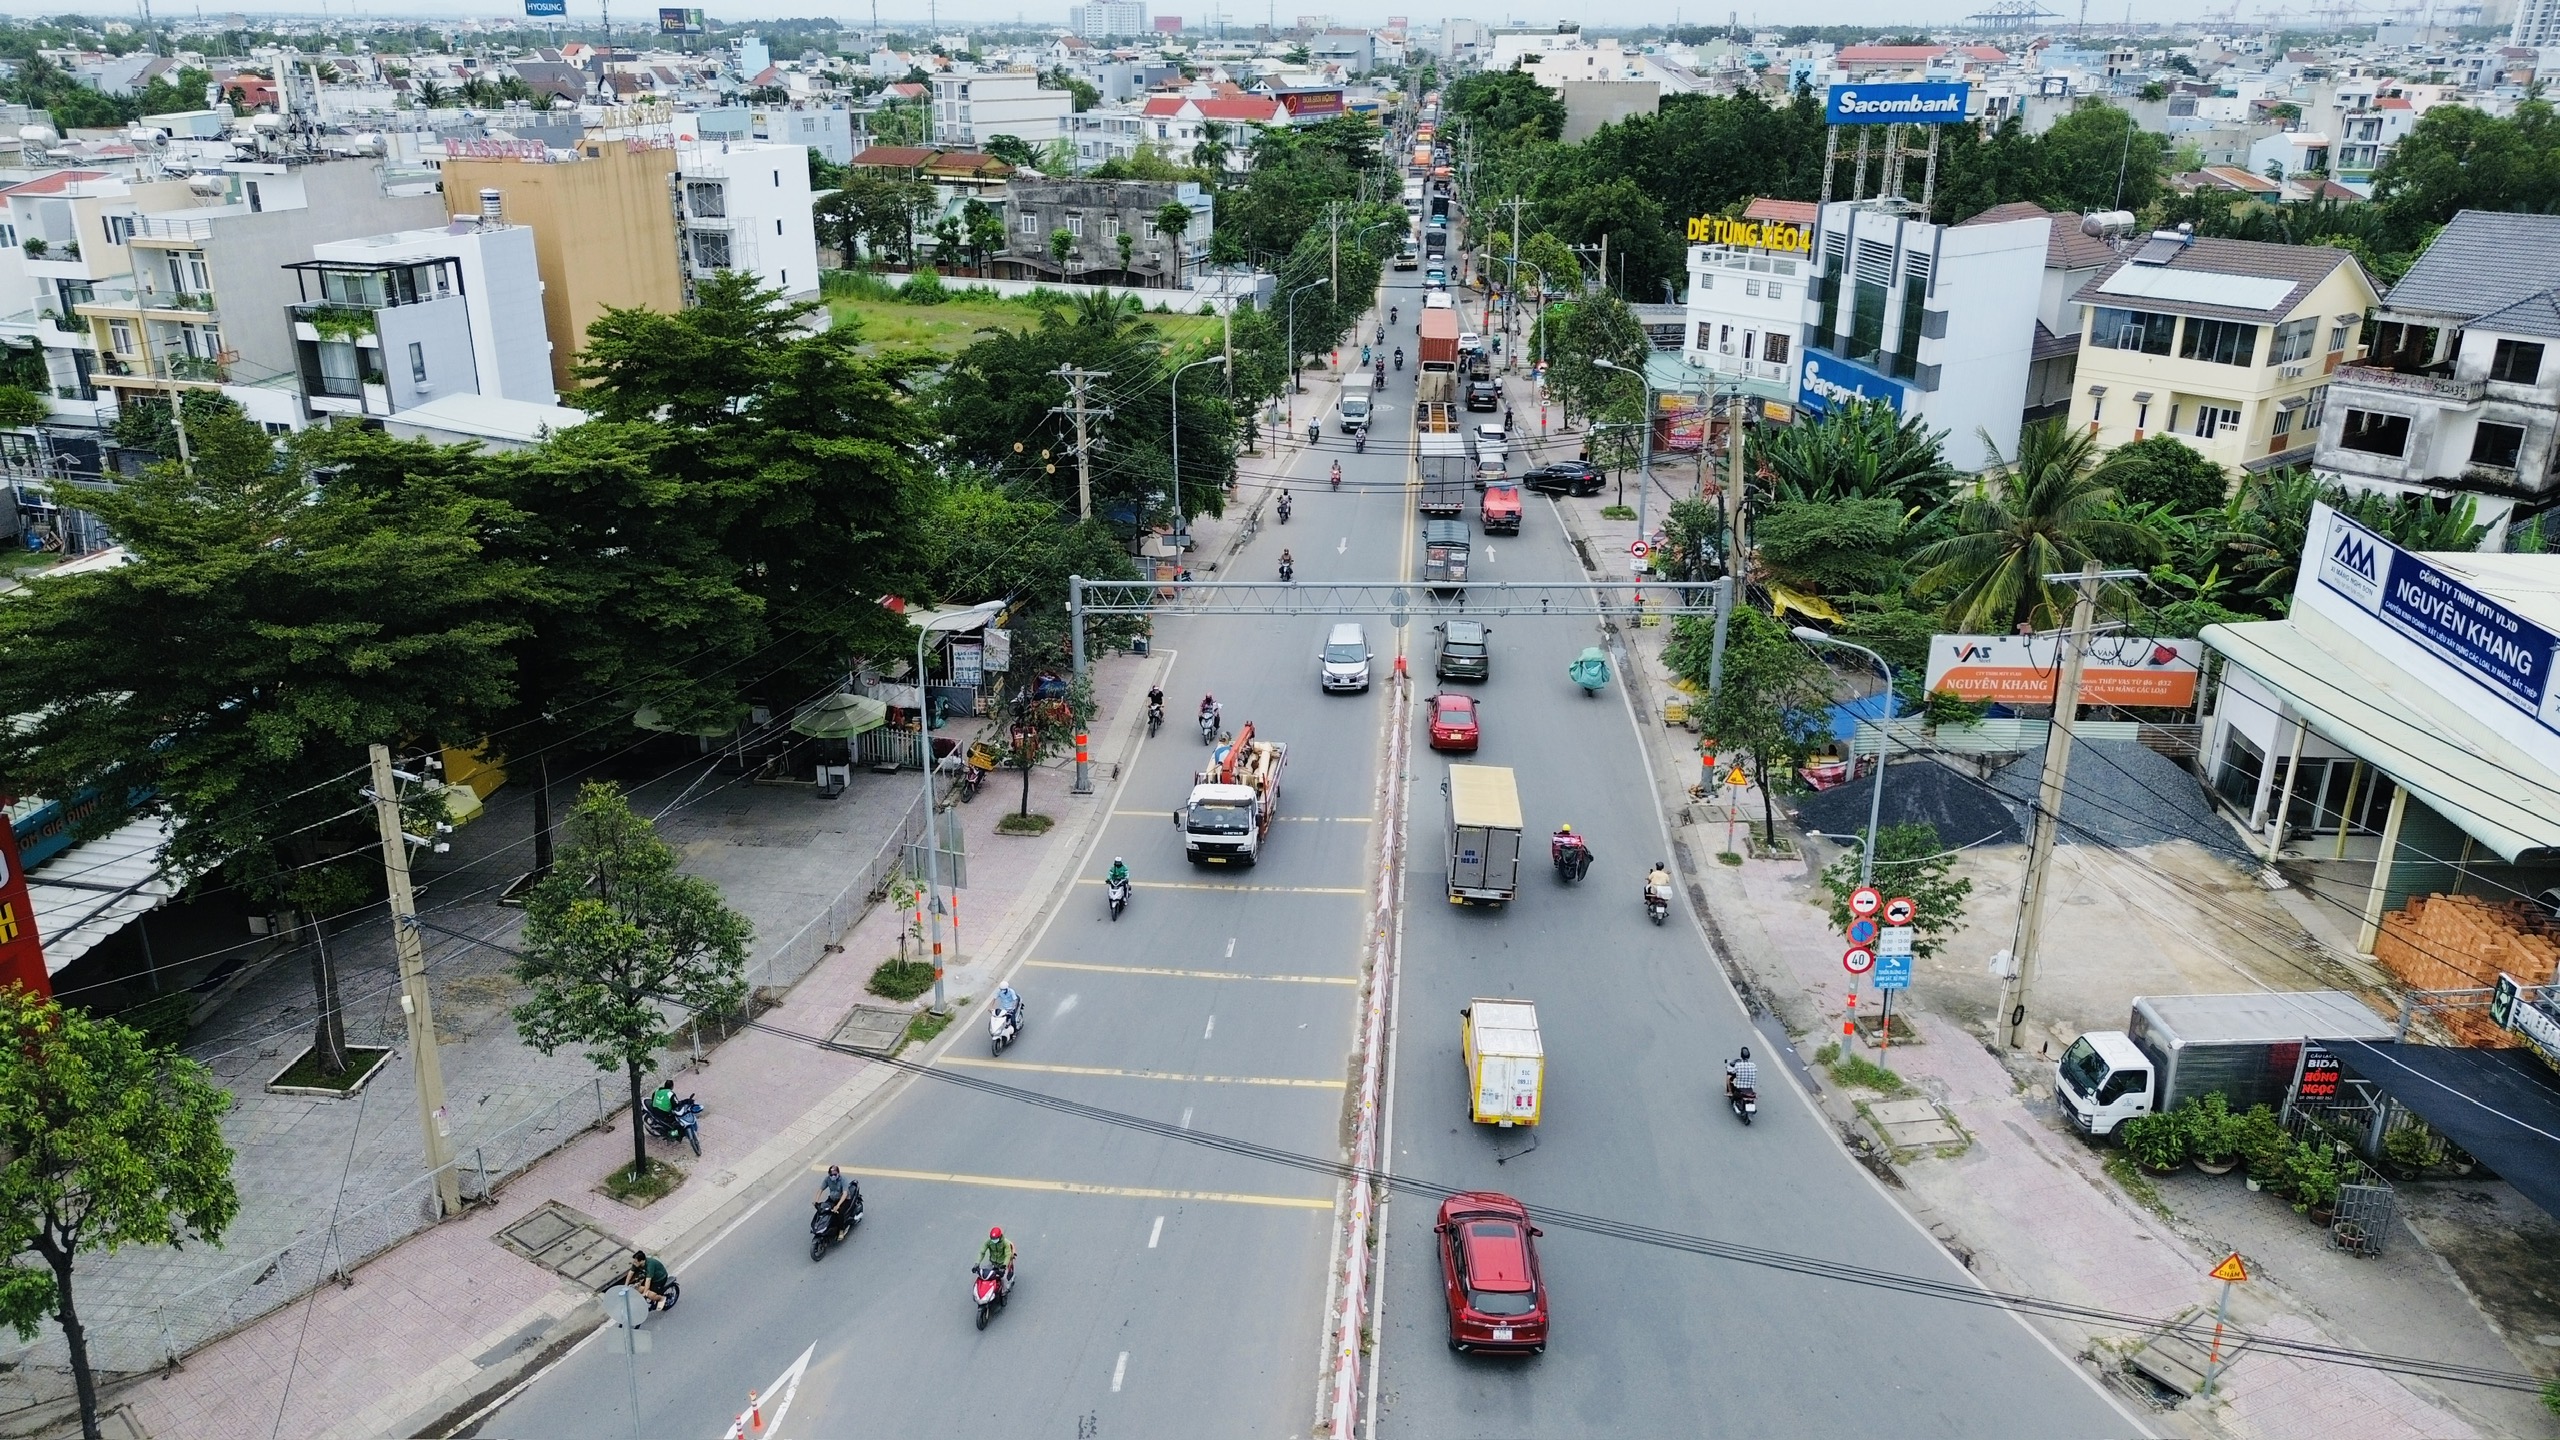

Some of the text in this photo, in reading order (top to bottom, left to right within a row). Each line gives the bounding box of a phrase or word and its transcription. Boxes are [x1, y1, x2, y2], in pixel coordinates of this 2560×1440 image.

[527, 3, 562, 11] HYOSUNG
[1838, 91, 1962, 114] Sacombank
[603, 101, 674, 129] MASSAGE
[445, 137, 547, 158] MASSAGE
[1687, 213, 1812, 253] DÊ TÙNG XÉO 4
[2419, 569, 2519, 633] CÔNG TY TNHH MTV VLXD
[2396, 578, 2466, 636] NGUYÊN
[2466, 619, 2533, 676] KHANG
[1953, 642, 1992, 662] VAS
[1946, 677, 2048, 690] NGUYÊN KHANG
[1852, 954, 1865, 965] 40
[2308, 1060, 2339, 1068] BIDA
[2304, 1068, 2339, 1082] HỒNG
[2301, 1084, 2336, 1095] NGỌC
